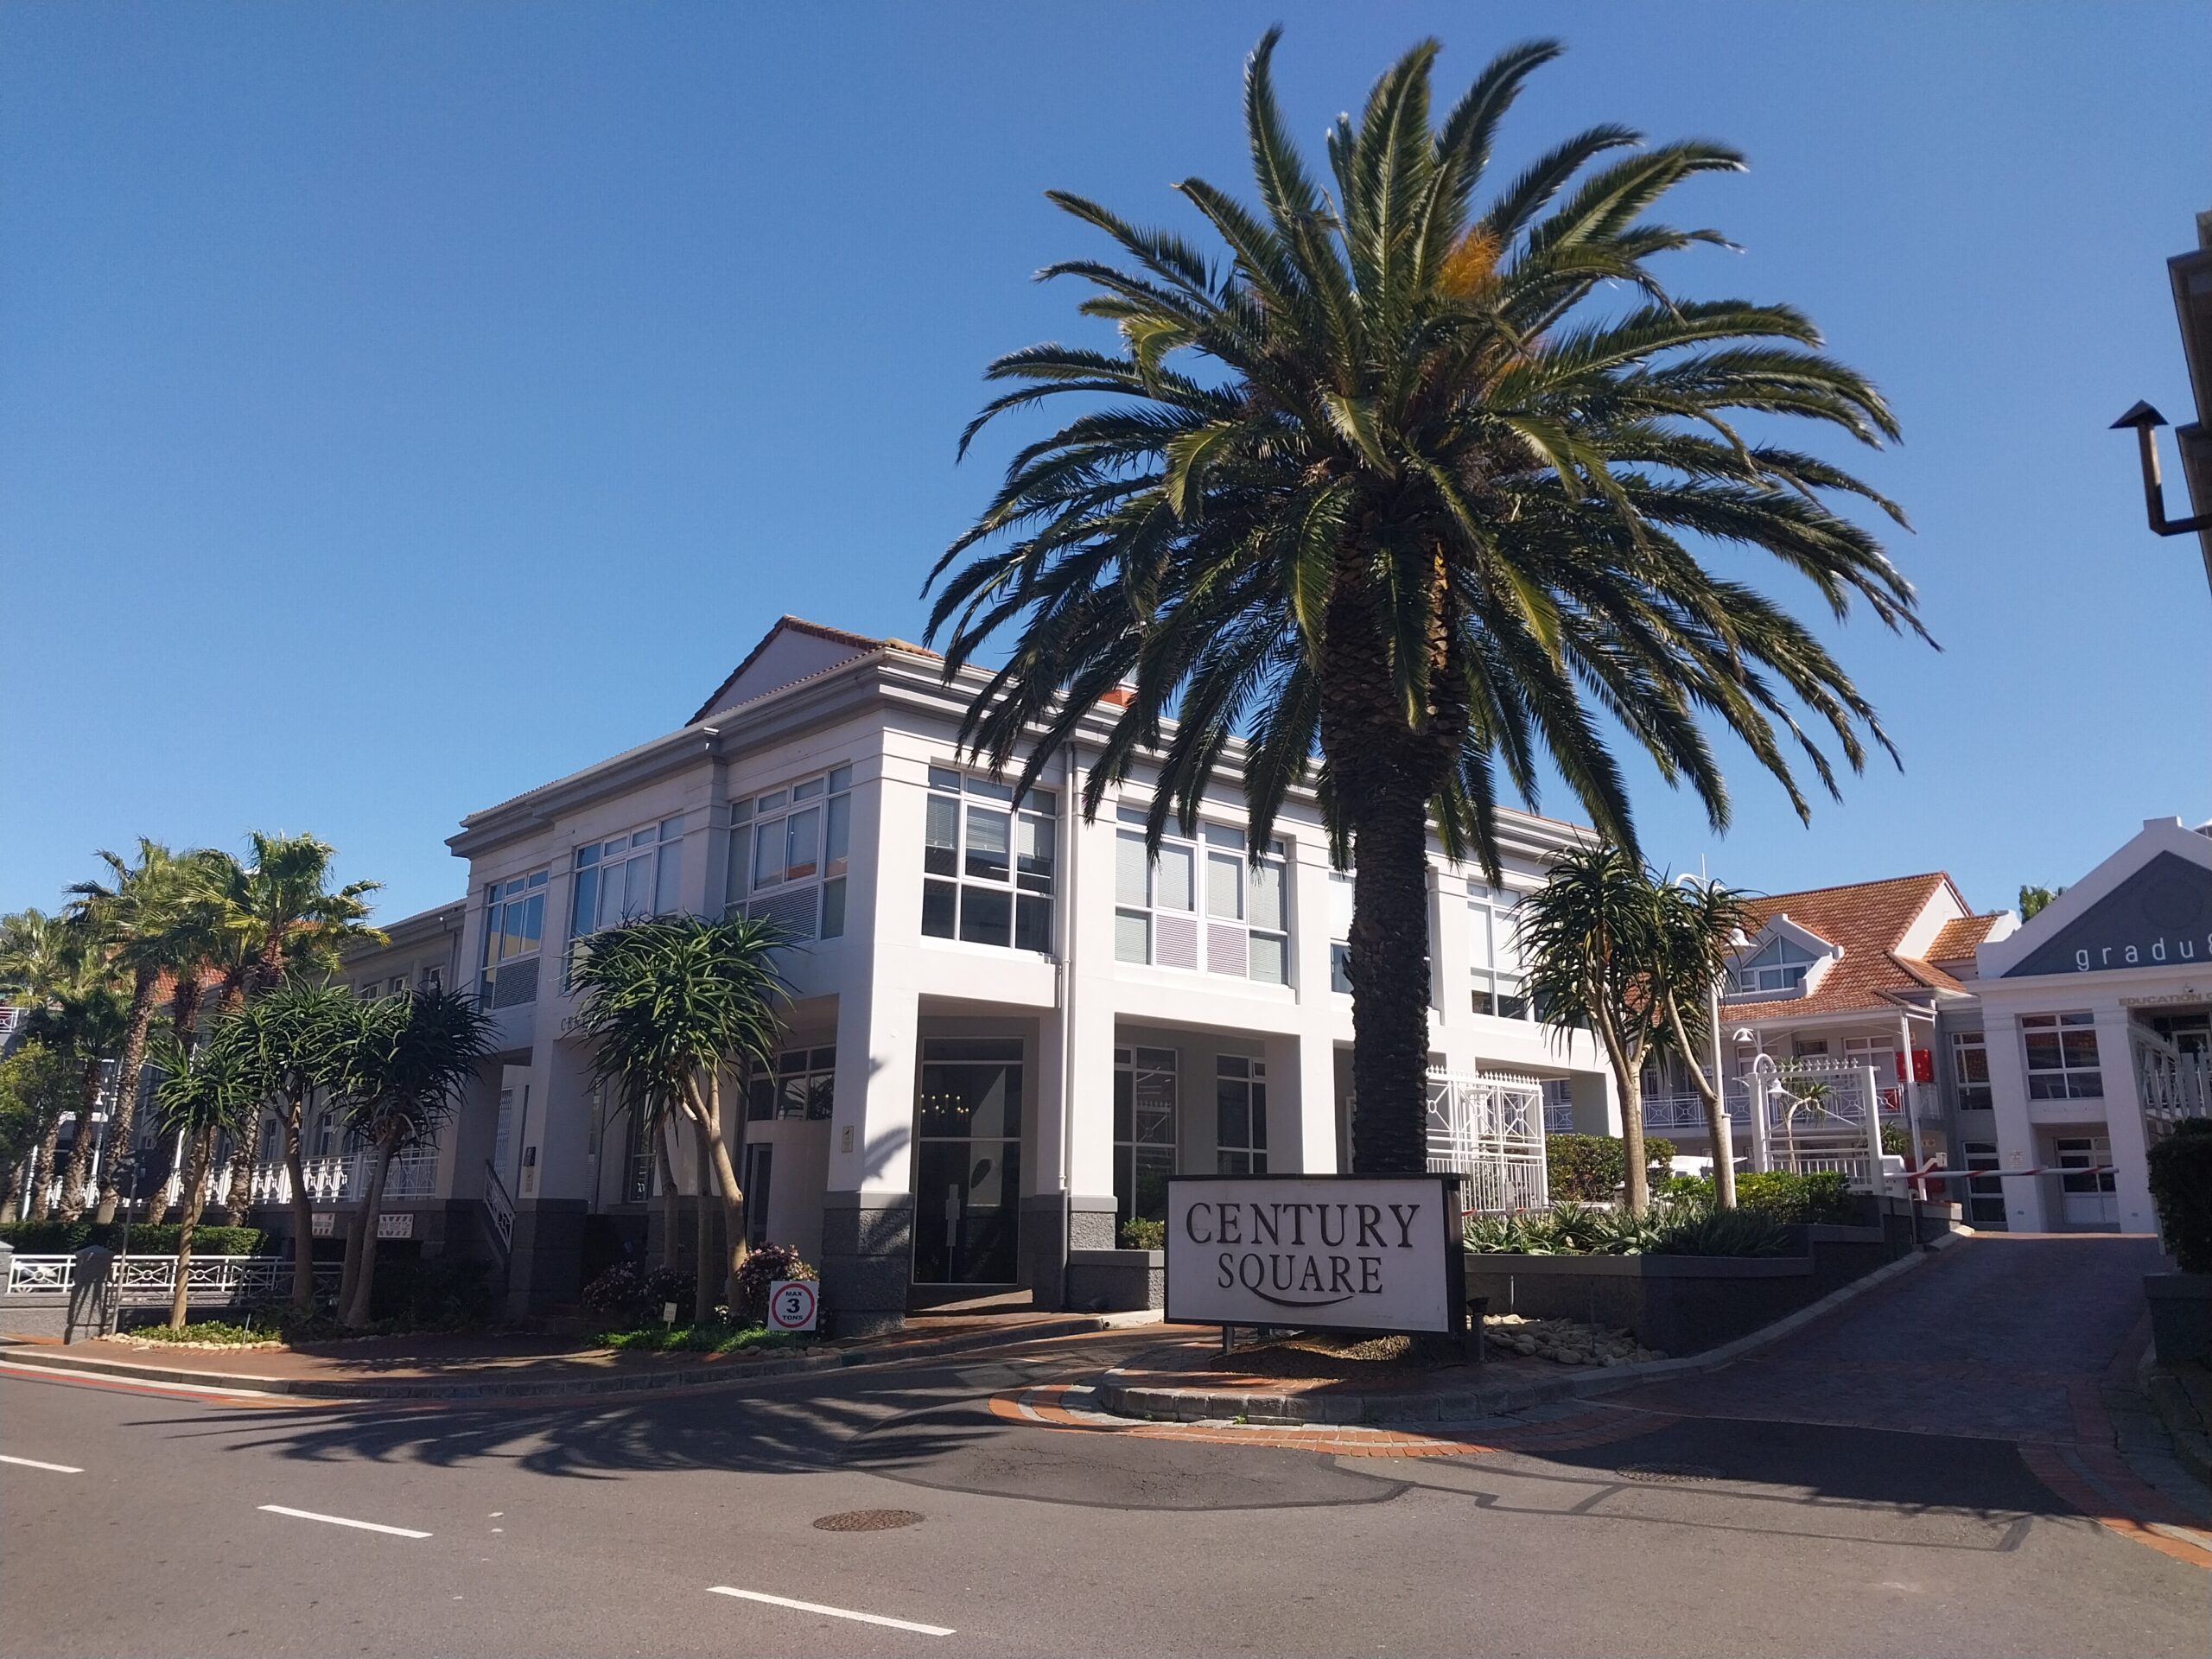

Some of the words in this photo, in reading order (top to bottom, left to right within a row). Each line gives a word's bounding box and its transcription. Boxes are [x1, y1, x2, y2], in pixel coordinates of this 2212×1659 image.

[2119, 994, 2202, 1006] EDUCATION
[1185, 1202, 1421, 1248] CENTURY
[1217, 1252, 1382, 1307] SQUARE
[786, 1298, 800, 1313] 3
